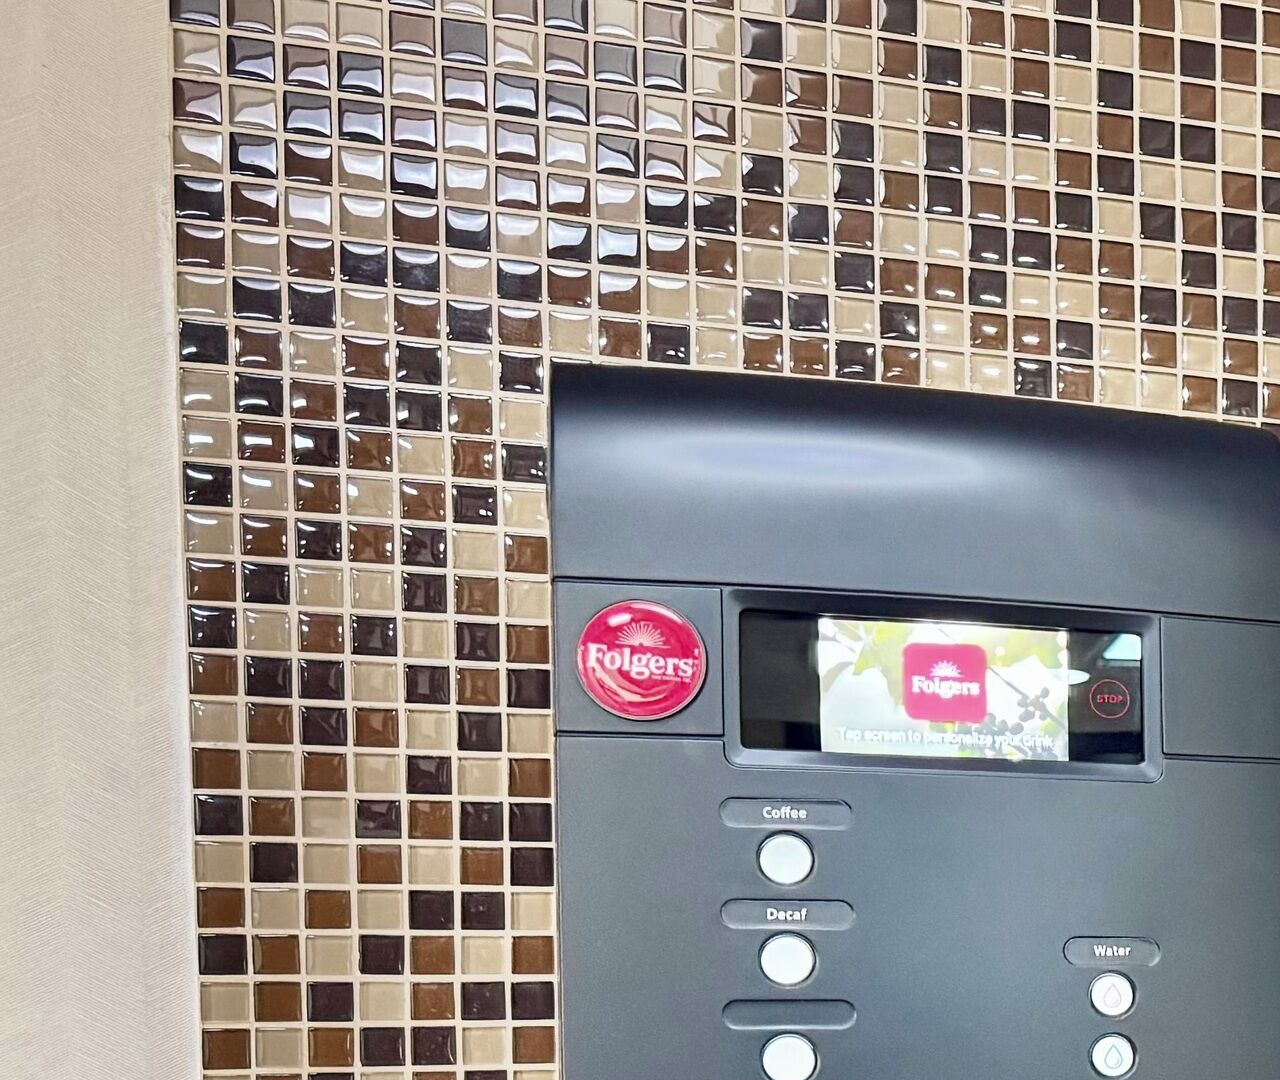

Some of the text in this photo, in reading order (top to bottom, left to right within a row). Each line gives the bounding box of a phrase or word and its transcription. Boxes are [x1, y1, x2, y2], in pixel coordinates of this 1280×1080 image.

[586, 641, 694, 681] Folgers
[911, 674, 980, 700] Folgers
[1097, 694, 1123, 703] STOP
[864, 729, 907, 744] screen
[908, 728, 921, 743] to
[762, 805, 807, 819] Coffee
[766, 907, 808, 921] Decaf
[1093, 944, 1131, 957] Water
